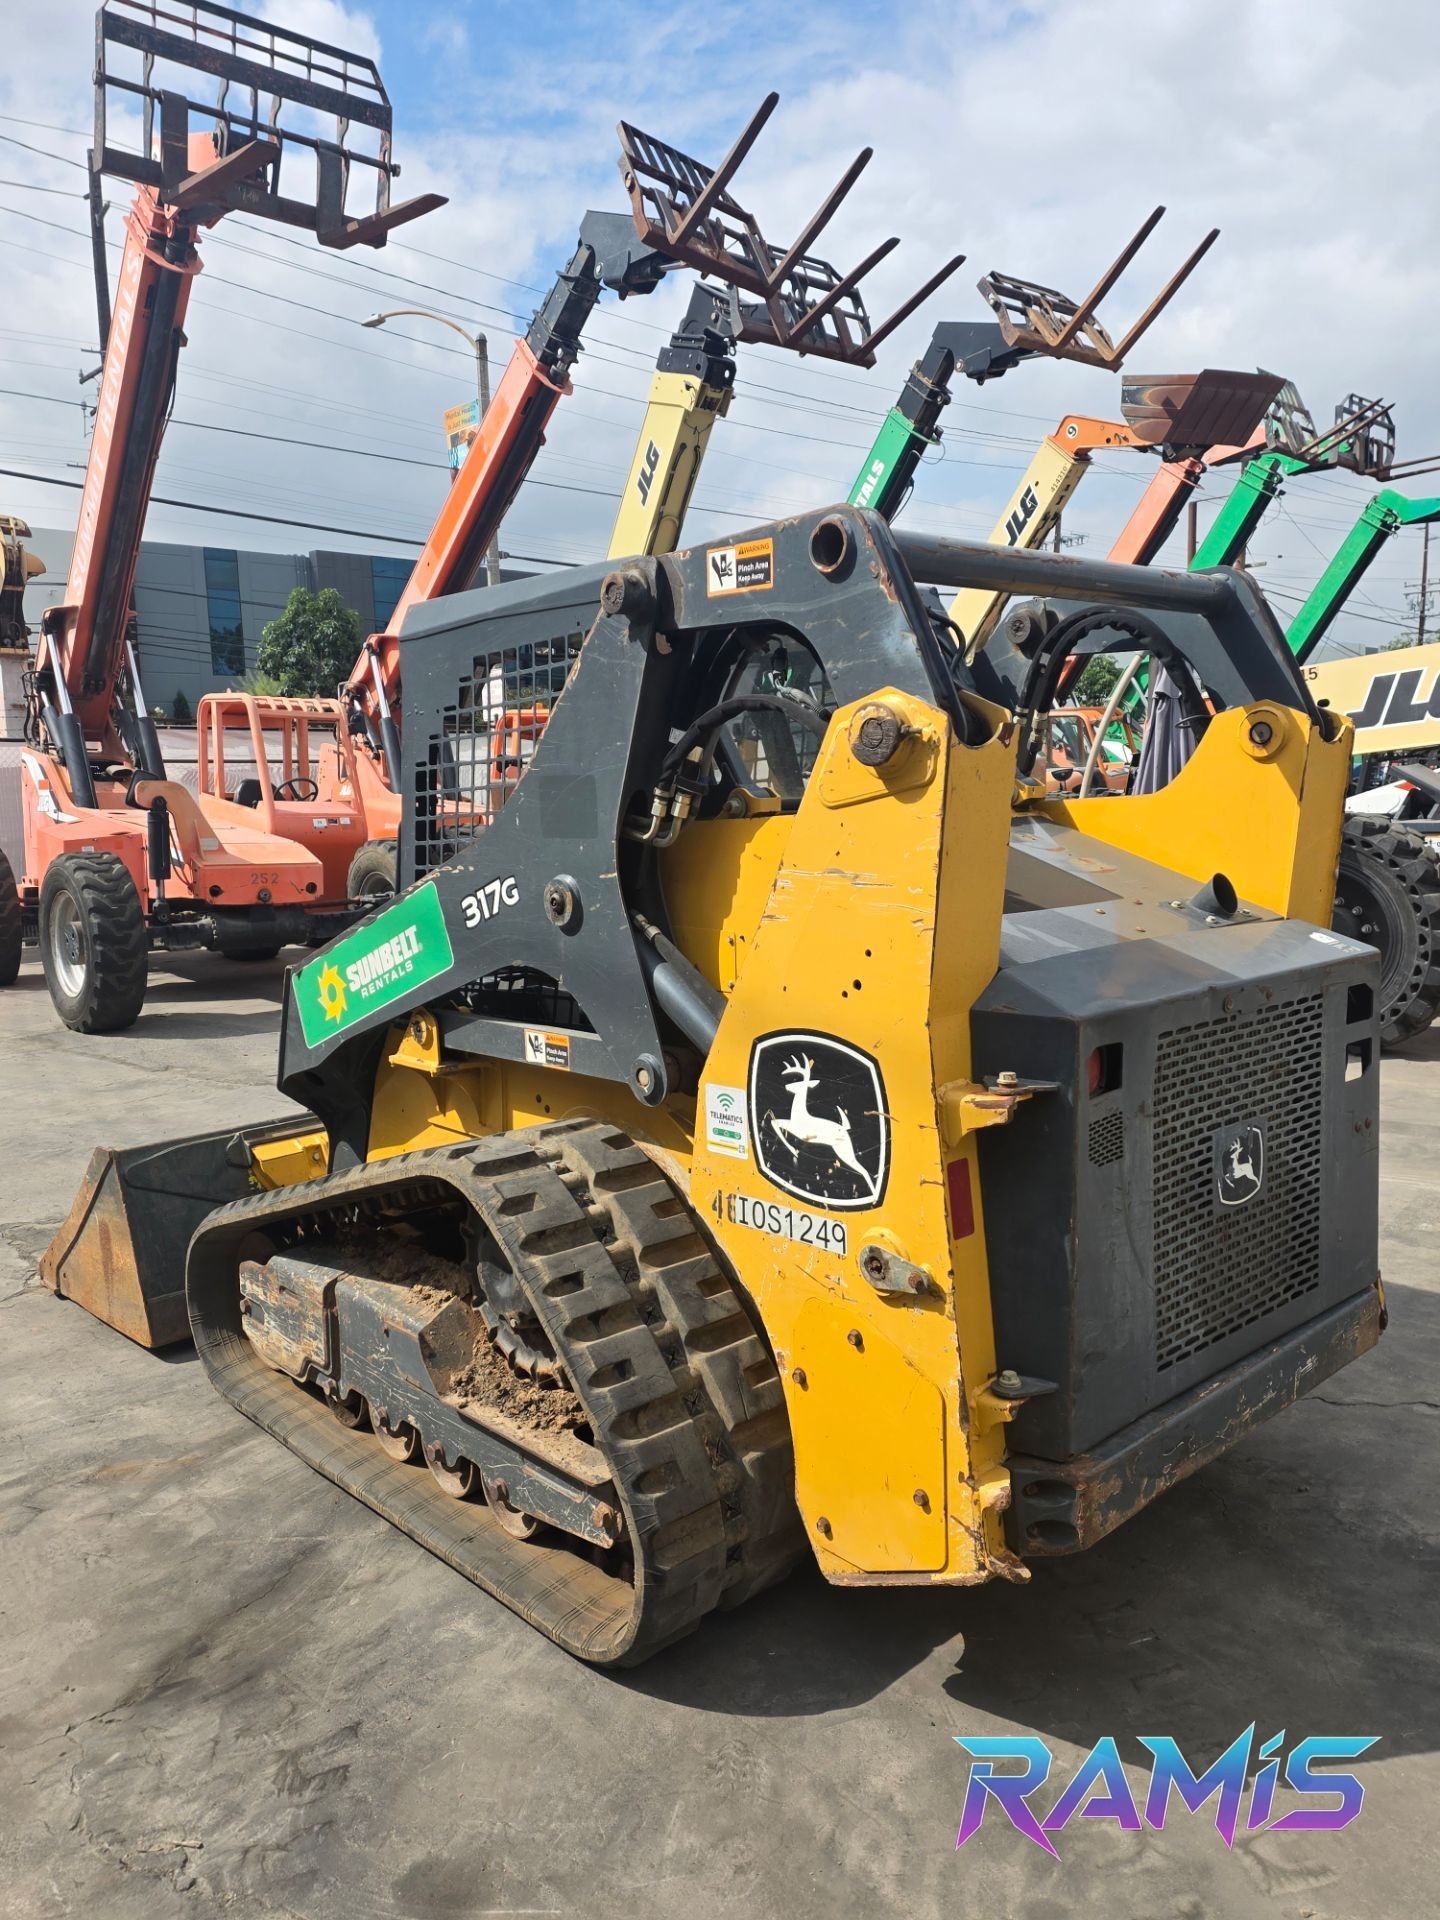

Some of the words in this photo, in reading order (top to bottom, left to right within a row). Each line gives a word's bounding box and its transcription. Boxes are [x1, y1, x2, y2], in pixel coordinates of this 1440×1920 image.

[72, 449, 105, 597] SUMMIT
[100, 252, 141, 438] RENTALS
[637, 439, 660, 507] JLG
[853, 459, 885, 508] TALS
[1004, 484, 1039, 547] JLG
[737, 562, 754, 573] Pinch
[754, 561, 769, 570] Area
[743, 543, 770, 554] WARNING
[737, 574, 751, 583] Keep
[751, 572, 764, 580] Away
[251, 872, 279, 885] 252
[461, 876, 520, 929] 317G
[346, 925, 419, 992] SUNBELT
[361, 960, 413, 999] RENTALS
[710, 1110, 743, 1124] TELEMATICS
